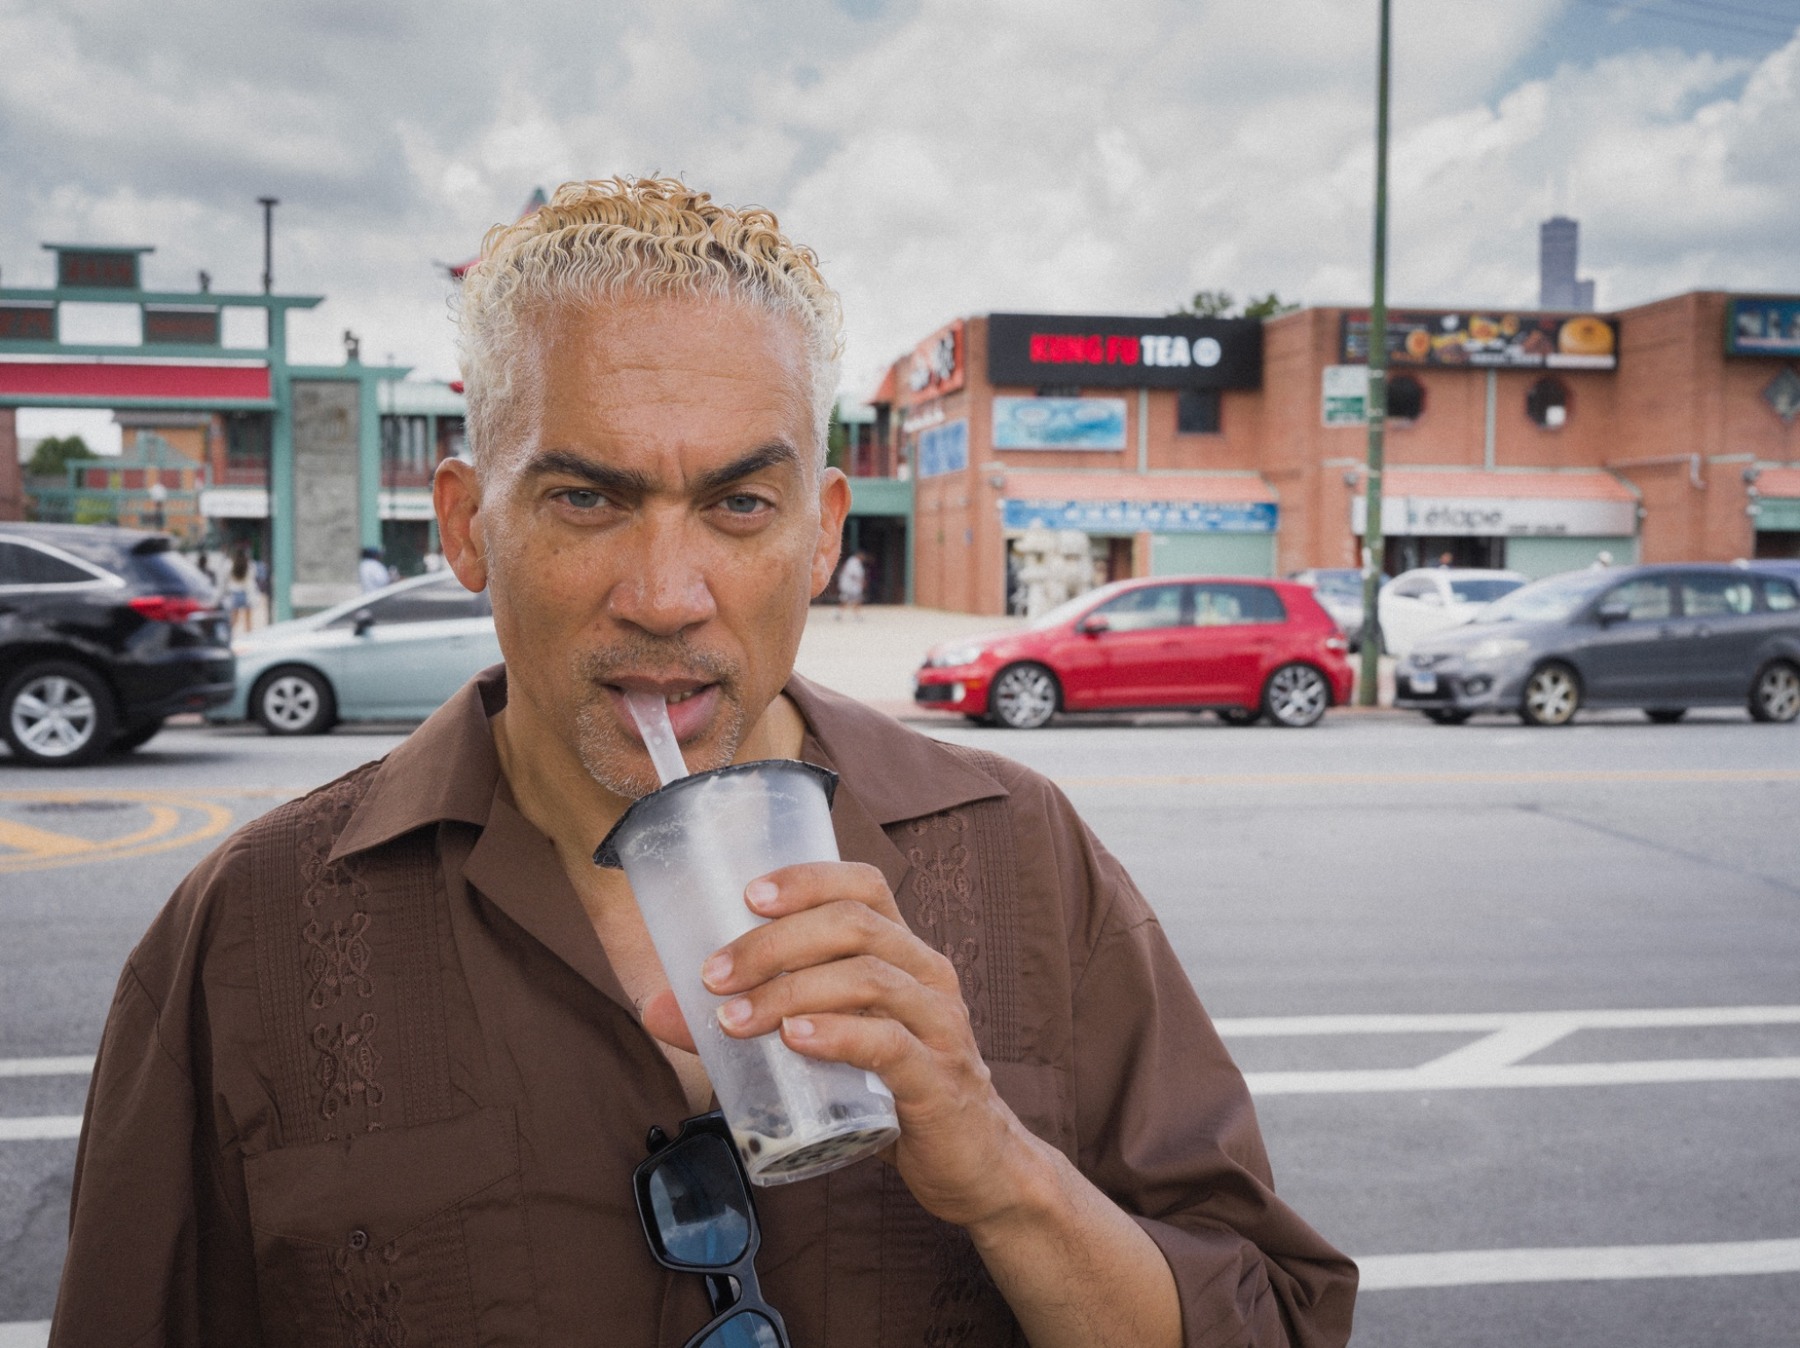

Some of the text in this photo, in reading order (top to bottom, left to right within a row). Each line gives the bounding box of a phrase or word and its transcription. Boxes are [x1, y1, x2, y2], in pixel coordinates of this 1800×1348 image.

[1030, 334, 1191, 367] KUNG FU TEA
